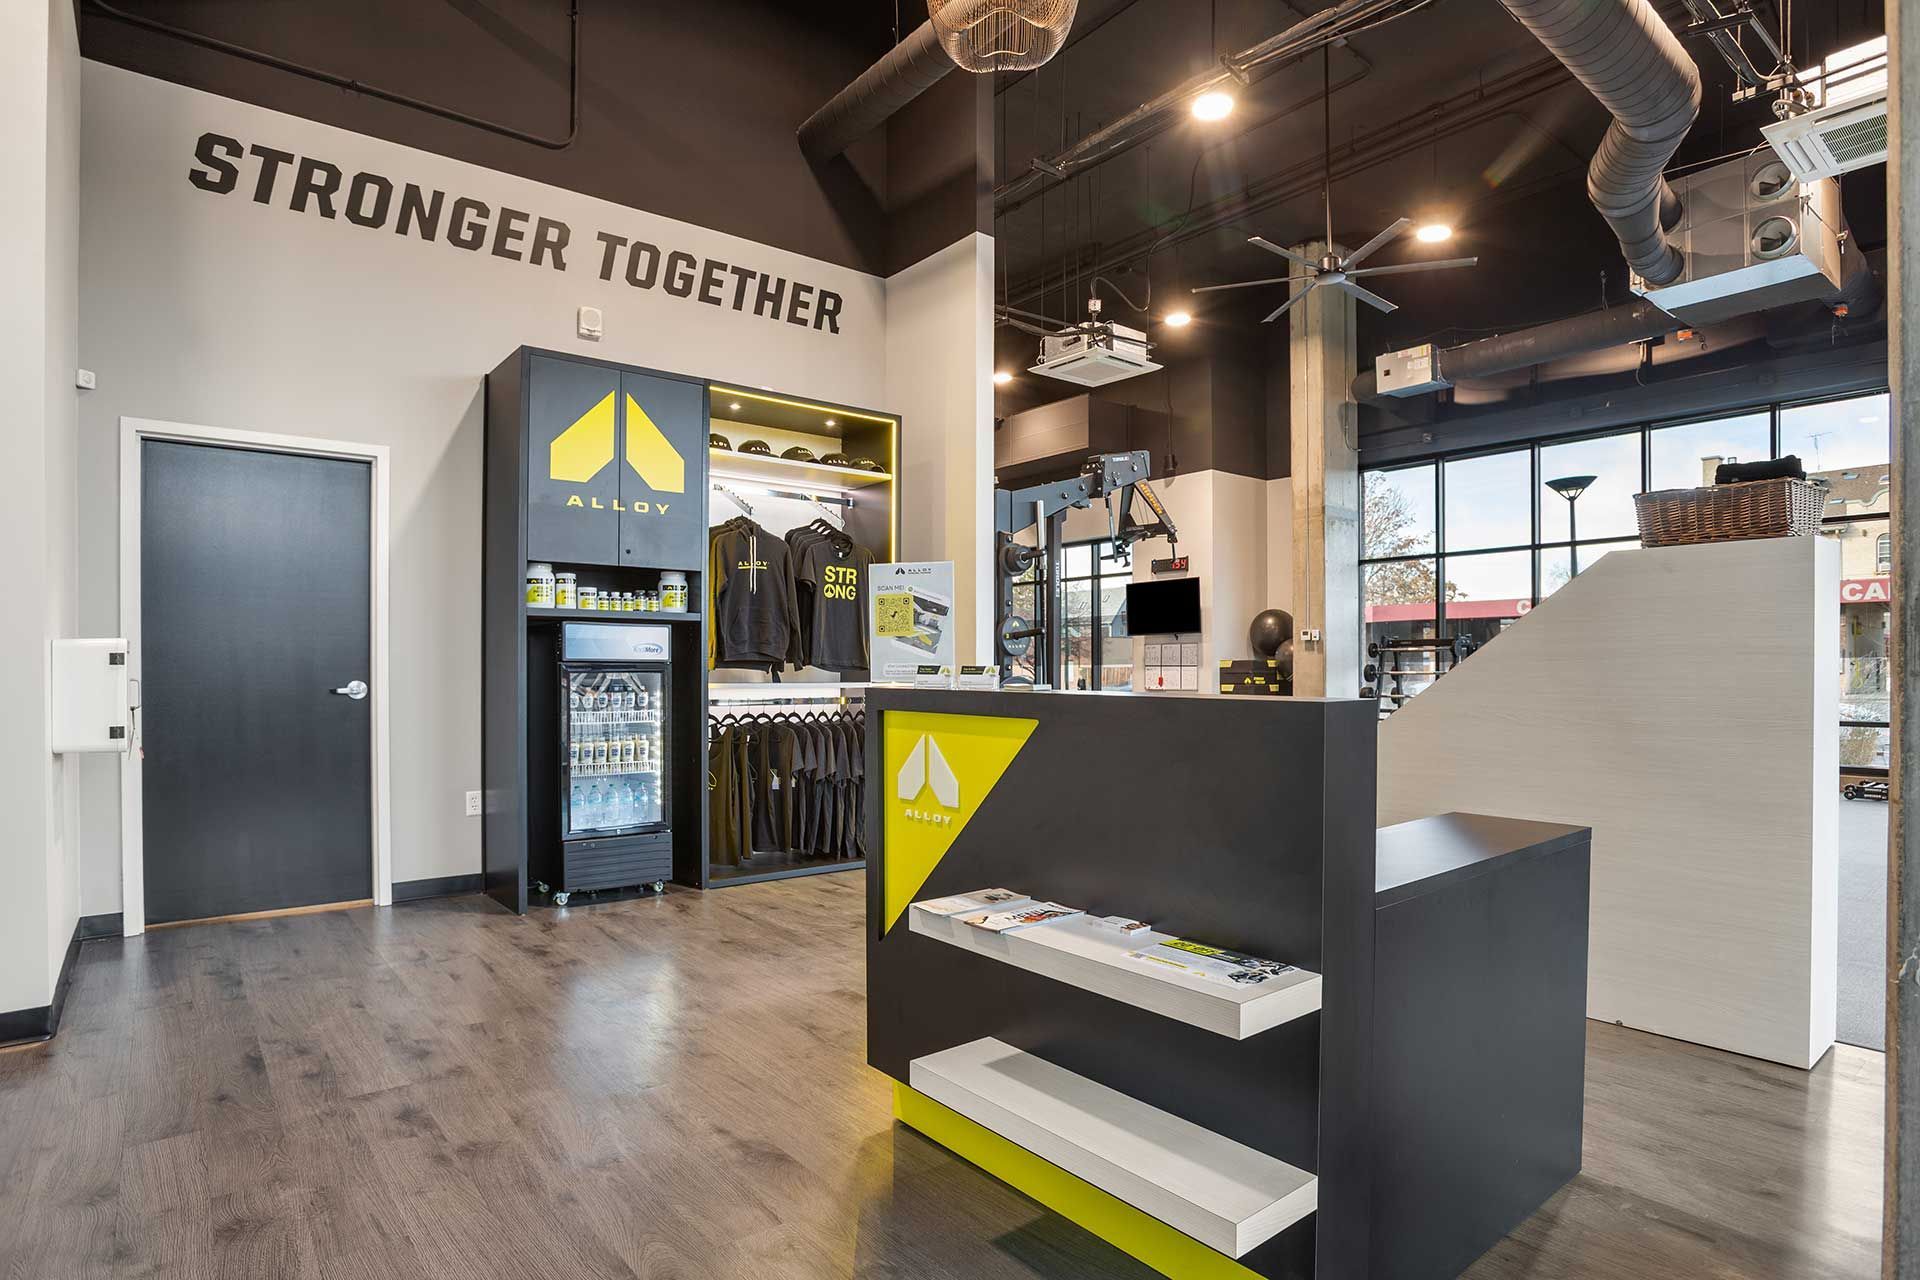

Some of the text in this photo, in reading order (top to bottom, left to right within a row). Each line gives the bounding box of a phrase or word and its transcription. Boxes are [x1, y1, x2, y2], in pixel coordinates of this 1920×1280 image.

[188, 132, 843, 335] STRONGER TOGETHER
[566, 495, 670, 514] ALLOY
[824, 565, 858, 585] STR
[1842, 581, 1890, 601] CA
[905, 808, 952, 825] ALLOY
